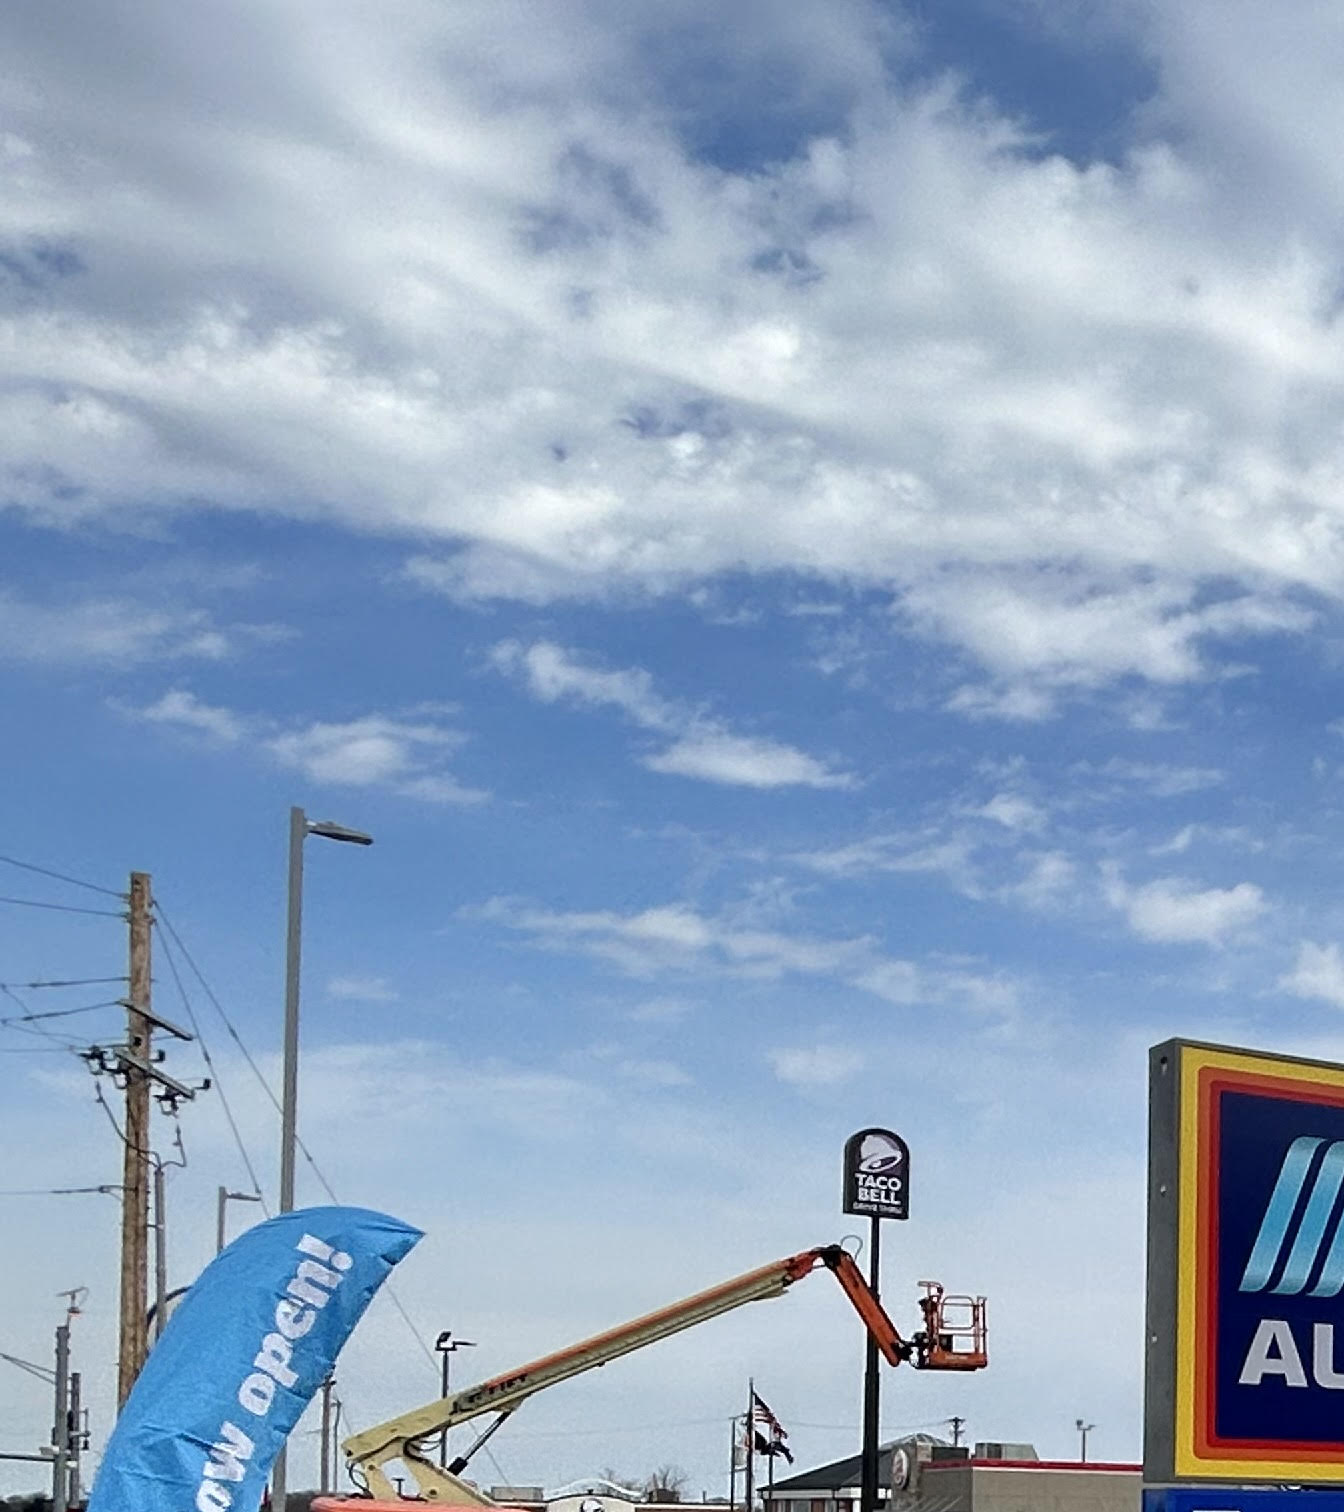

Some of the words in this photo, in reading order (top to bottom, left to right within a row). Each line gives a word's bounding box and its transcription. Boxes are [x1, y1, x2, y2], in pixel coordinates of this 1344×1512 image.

[854, 1172, 901, 1191] TACO
[858, 1187, 901, 1205] BELL
[238, 1233, 353, 1416] open!
